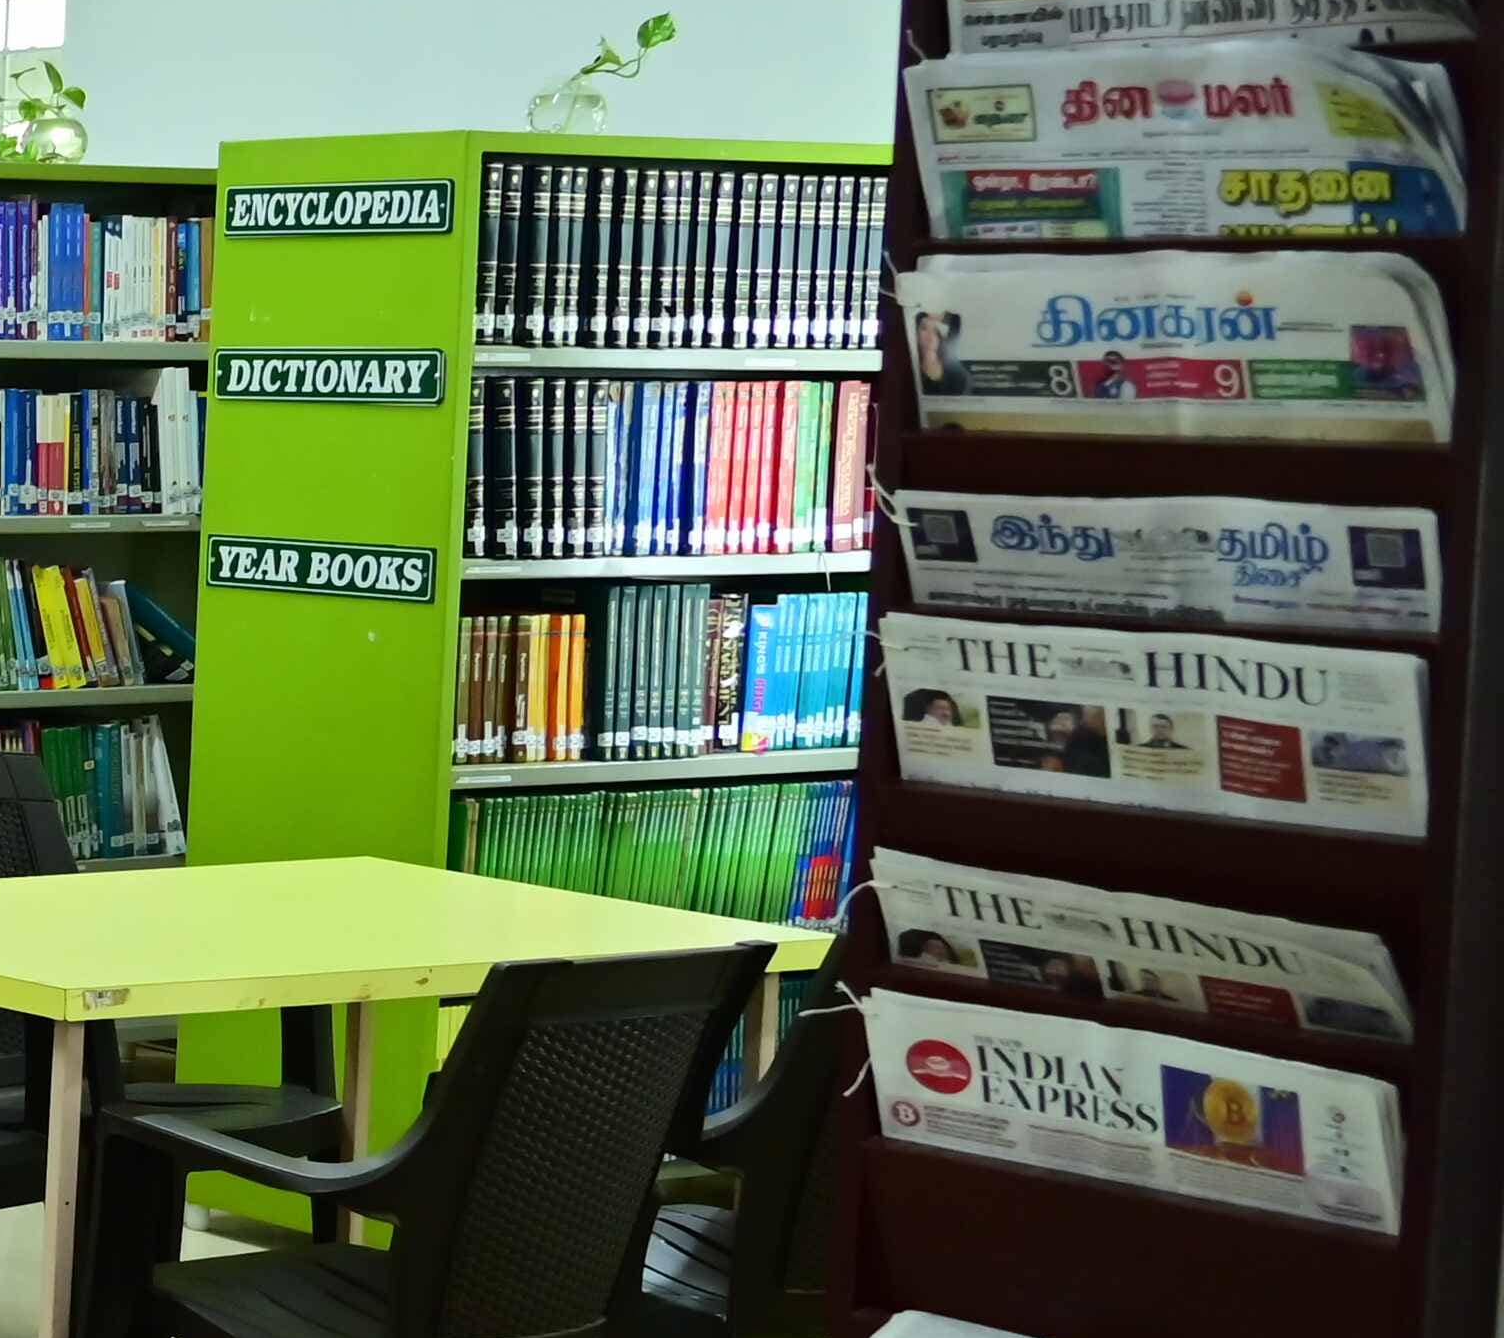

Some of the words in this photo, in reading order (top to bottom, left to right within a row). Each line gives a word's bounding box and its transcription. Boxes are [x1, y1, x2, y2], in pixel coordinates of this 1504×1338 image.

[231, 189, 441, 228] ENCYCLOPEDIA
[227, 359, 431, 394] DICTIONARY
[1048, 366, 1072, 396] 8
[1214, 364, 1239, 396] 9
[218, 545, 300, 582] YEAR
[308, 552, 423, 593] BOOKS
[947, 637, 1056, 679] THE
[1145, 651, 1328, 706] HINDU
[935, 884, 1042, 930] THE
[1121, 916, 1306, 975] HINDU
[977, 1044, 1125, 1097] INDIAN
[981, 1074, 1159, 1134] EXPRESS
